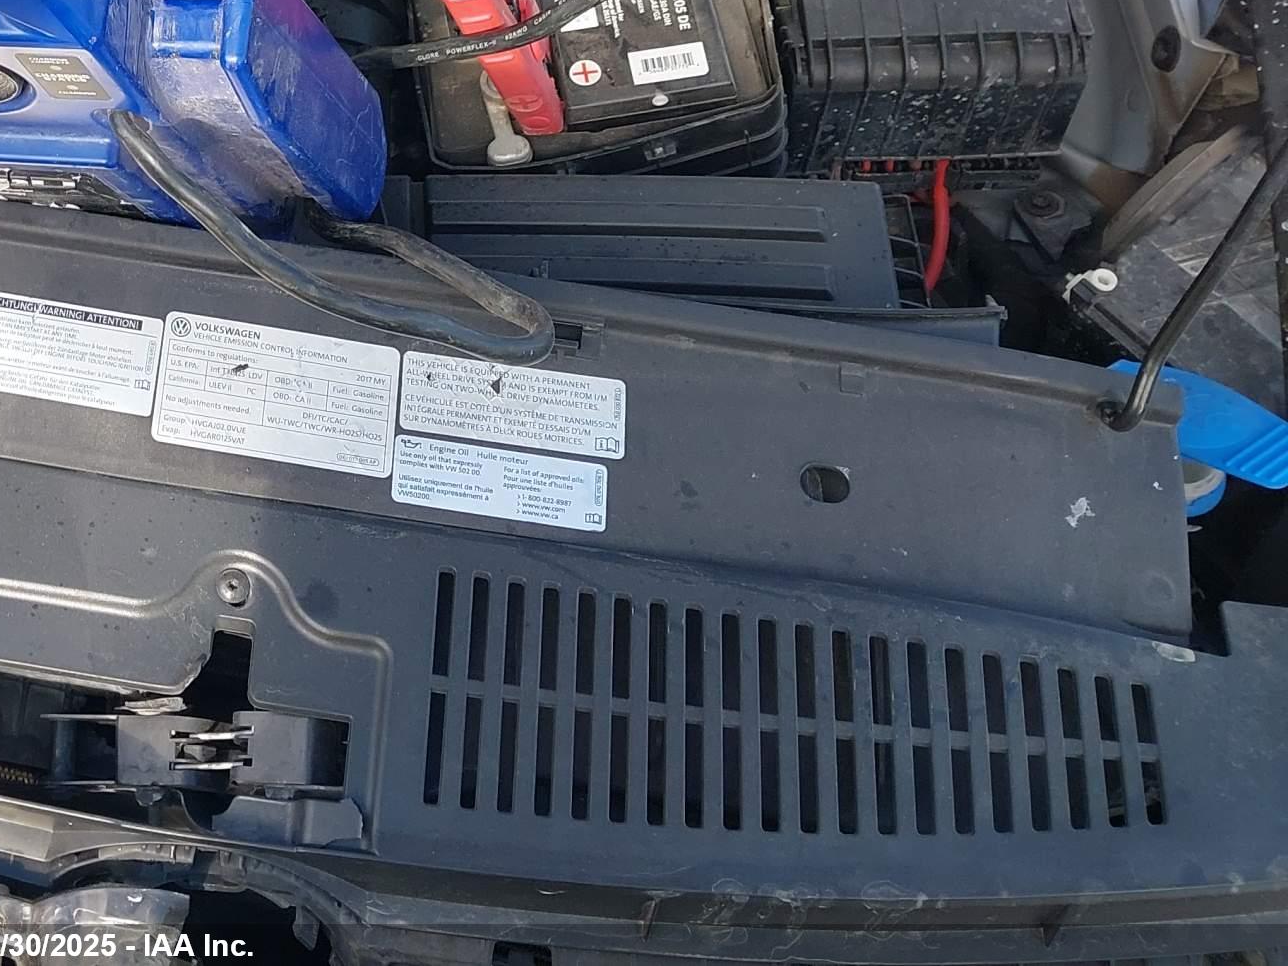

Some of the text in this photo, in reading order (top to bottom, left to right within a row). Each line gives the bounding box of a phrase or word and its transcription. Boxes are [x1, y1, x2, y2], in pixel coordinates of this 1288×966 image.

[677, 15, 692, 30] DE
[41, 306, 85, 320] WARNING!
[86, 314, 140, 331] ATTENTION!
[194, 321, 261, 340] VOLKSWAGEN
[172, 343, 258, 365] Conforms to regulations:
[193, 331, 348, 363] VEHICLE EMISSION CONTROL INFORMATION
[170, 359, 182, 367] U.S.
[248, 372, 263, 380] LDV
[357, 374, 386, 385] 2017 MY
[408, 358, 424, 367] THIS
[427, 361, 458, 372] VEHICLE
[461, 365, 467, 373] IS
[512, 373, 532, 382] WITH
[534, 375, 540, 383] A
[542, 377, 590, 390] PERMANENT
[407, 368, 607, 402] ALL-WHEEL DRIVE AND IS EXEMPT FROM I/M
[294, 394, 305, 403] CA
[333, 386, 384, 401] Fuel: Gasoline
[406, 378, 438, 389] TESTING
[441, 383, 452, 391] ON
[507, 392, 529, 402] DRIVE
[532, 395, 600, 411] DYNAMOMETERS.
[165, 394, 221, 410] No adjustments
[331, 401, 383, 416] Fuel: Gasoline
[405, 394, 415, 402] CE
[416, 394, 453, 407] VÉHICULE
[456, 400, 469, 409] EST
[514, 407, 547, 420] SYSTÈME
[549, 413, 559, 422] DE
[561, 415, 617, 430] TRANSMISSION
[447, 409, 492, 422] PERMANENT
[494, 416, 503, 424] ET
[539, 422, 570, 434] D'ESSAIS
[404, 413, 419, 422] SUR
[518, 429, 543, 440] ROUES
[545, 433, 585, 446] MOTRICES.
[400, 450, 412, 458] Use
[414, 452, 427, 461] only
[439, 456, 451, 464] that
[430, 443, 456, 456] Engine
[458, 447, 469, 456] Oil
[500, 455, 528, 466] moteur
[399, 458, 428, 469] complies
[430, 462, 444, 470] with
[398, 473, 422, 483] Utilisez
[424, 477, 463, 490] uniquement
[504, 474, 518, 482] Pour
[521, 468, 531, 476] list
[541, 471, 571, 483] approved
[398, 481, 408, 490] qui
[410, 483, 434, 493] satisfait
[522, 503, 565, 514] www.vw.com
[522, 509, 559, 520] www.vw.ca
